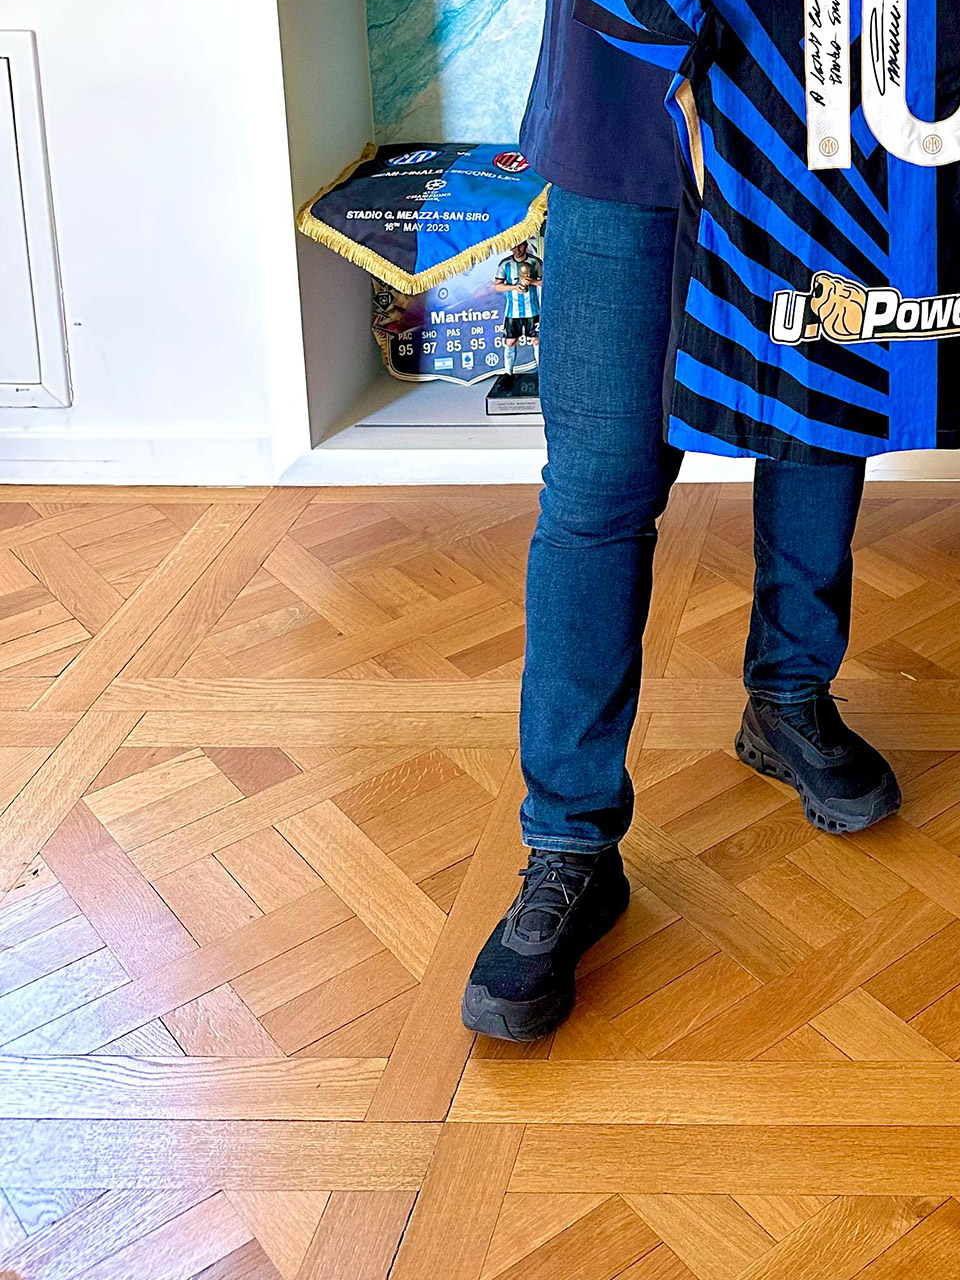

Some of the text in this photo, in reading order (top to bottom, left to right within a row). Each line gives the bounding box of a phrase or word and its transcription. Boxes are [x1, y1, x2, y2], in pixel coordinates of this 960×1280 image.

[346, 210, 490, 222] STADIO G. MEAZZA-SAN SIRO
[403, 223, 423, 232] MAY
[426, 223, 450, 232] 2023
[431, 308, 499, 325] Martínez
[398, 332, 413, 341] PAC
[422, 330, 437, 339] SHO
[446, 328, 461, 337] PAS
[471, 326, 484, 336] DRI
[398, 343, 414, 356] 95
[423, 341, 438, 354] 97
[446, 339, 462, 352] 85
[470, 337, 486, 350] 95
